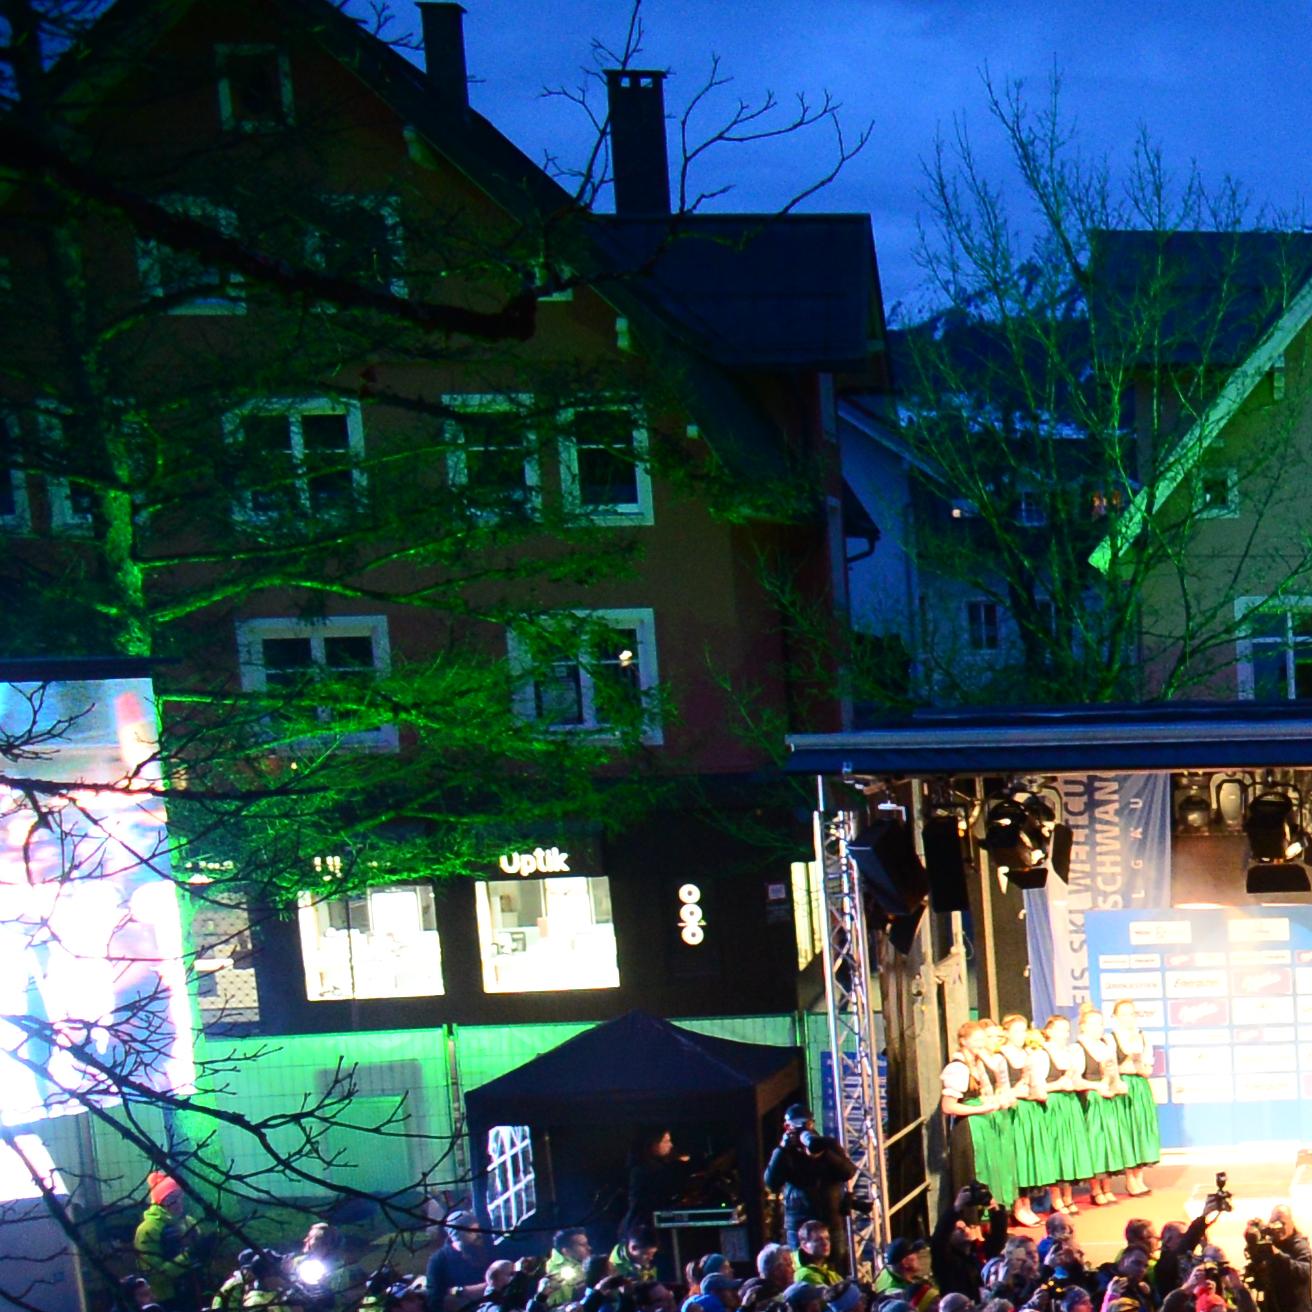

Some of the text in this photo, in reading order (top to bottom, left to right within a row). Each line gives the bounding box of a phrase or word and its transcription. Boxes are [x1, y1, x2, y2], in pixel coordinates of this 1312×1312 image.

[1063, 778, 1092, 896] WELTCU
[1094, 774, 1124, 911] SCHWAN
[1130, 797, 1145, 899] LGÄU
